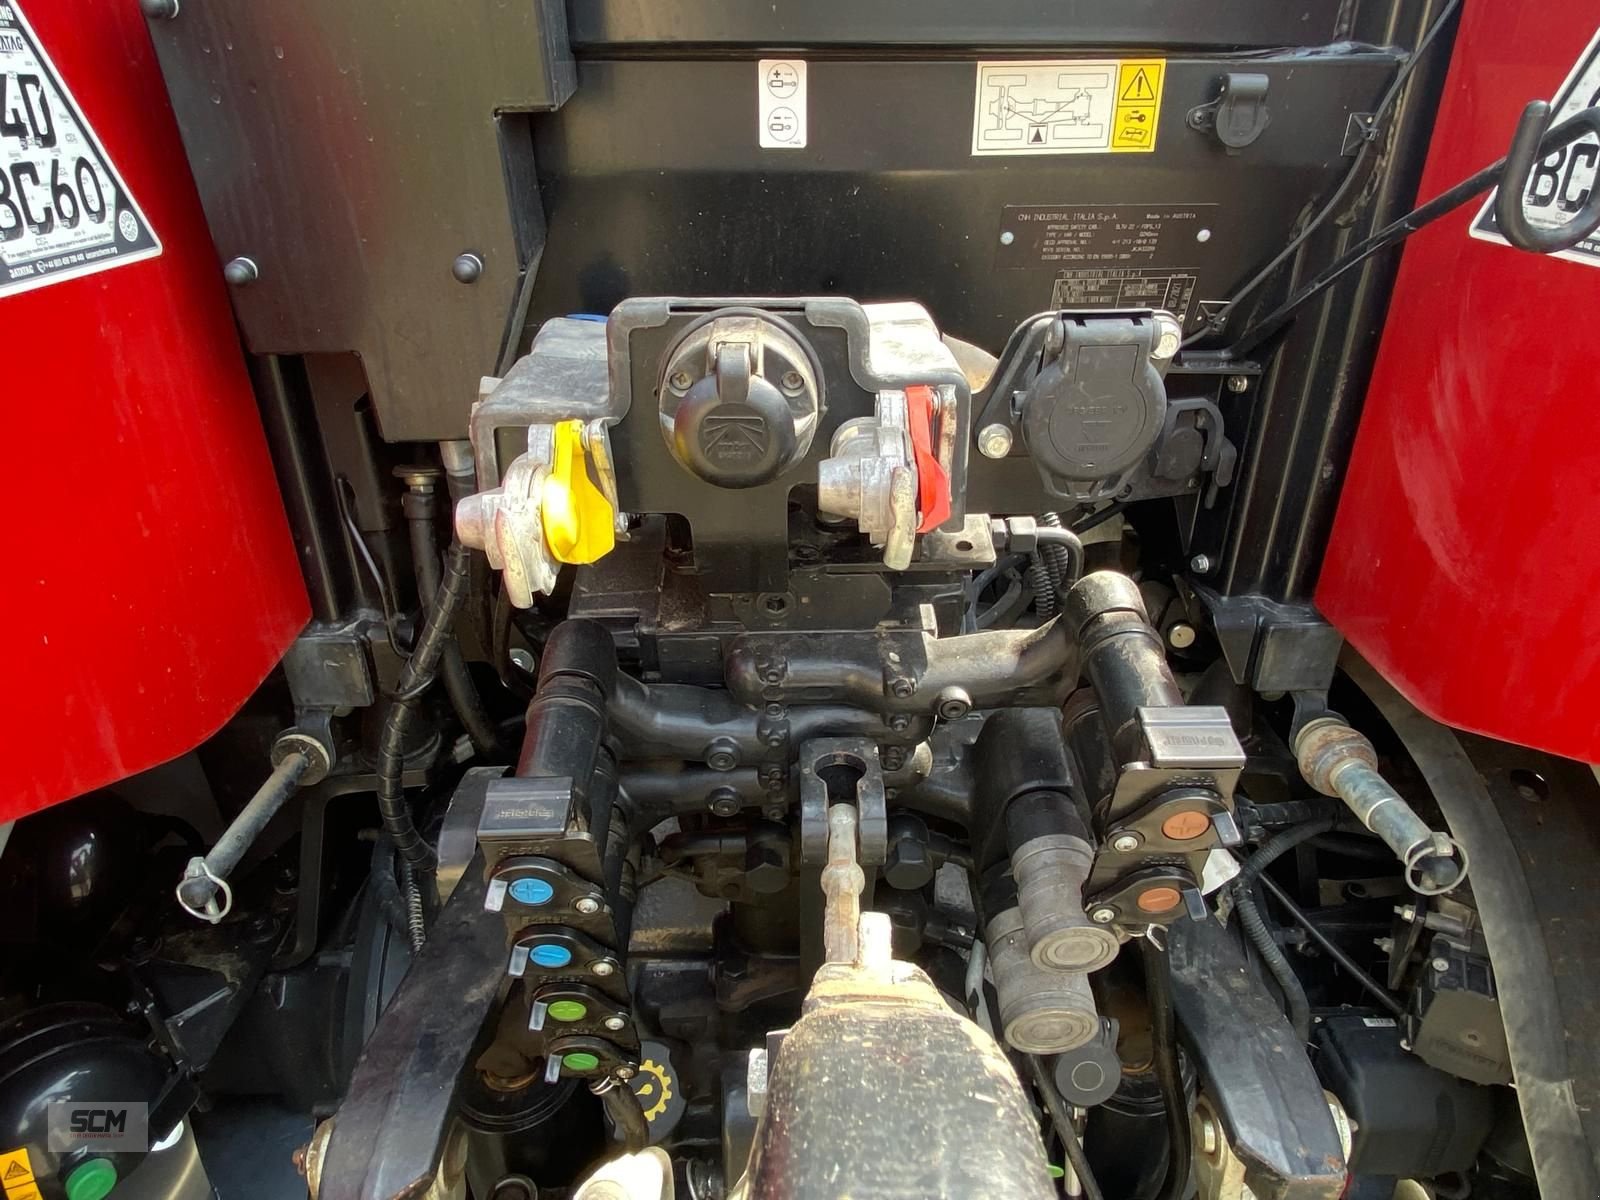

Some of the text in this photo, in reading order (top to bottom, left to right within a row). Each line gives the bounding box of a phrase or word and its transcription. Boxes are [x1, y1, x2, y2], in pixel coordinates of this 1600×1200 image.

[0, 35, 24, 51] ATAG
[1034, 213, 1069, 221] INDUSTRIAL
[1073, 212, 1095, 221] ITALIA
[498, 846, 551, 856] Faster
